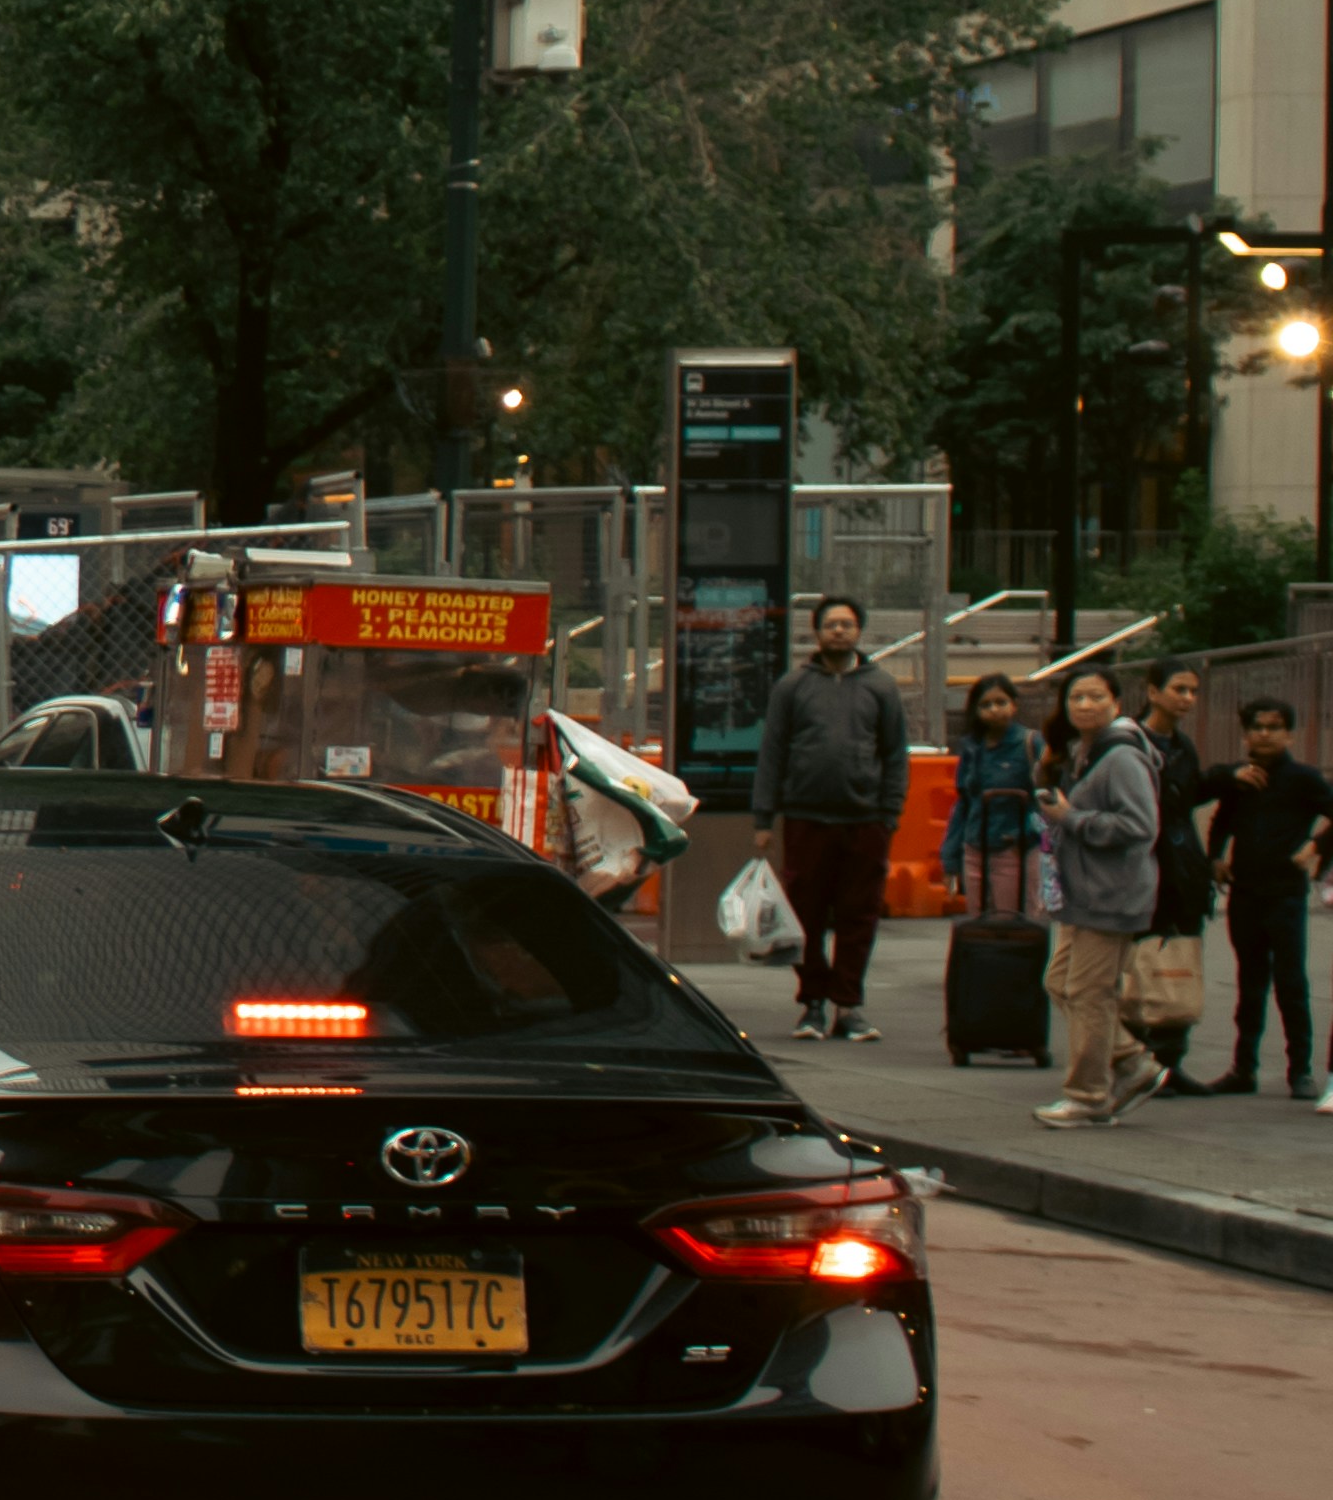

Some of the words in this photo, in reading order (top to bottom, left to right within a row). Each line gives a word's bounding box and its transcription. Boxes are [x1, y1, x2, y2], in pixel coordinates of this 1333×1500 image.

[352, 591, 420, 607] HONEY
[425, 593, 515, 611] ROASTED
[360, 607, 381, 623] 1.
[388, 608, 508, 627] PEANUTS
[358, 623, 381, 640] 2.
[387, 624, 506, 644] ALMONDS
[274, 1203, 577, 1220] CAMRY
[357, 1253, 407, 1267] NEW
[411, 1254, 468, 1269] YORK
[321, 1278, 504, 1331] T679517C
